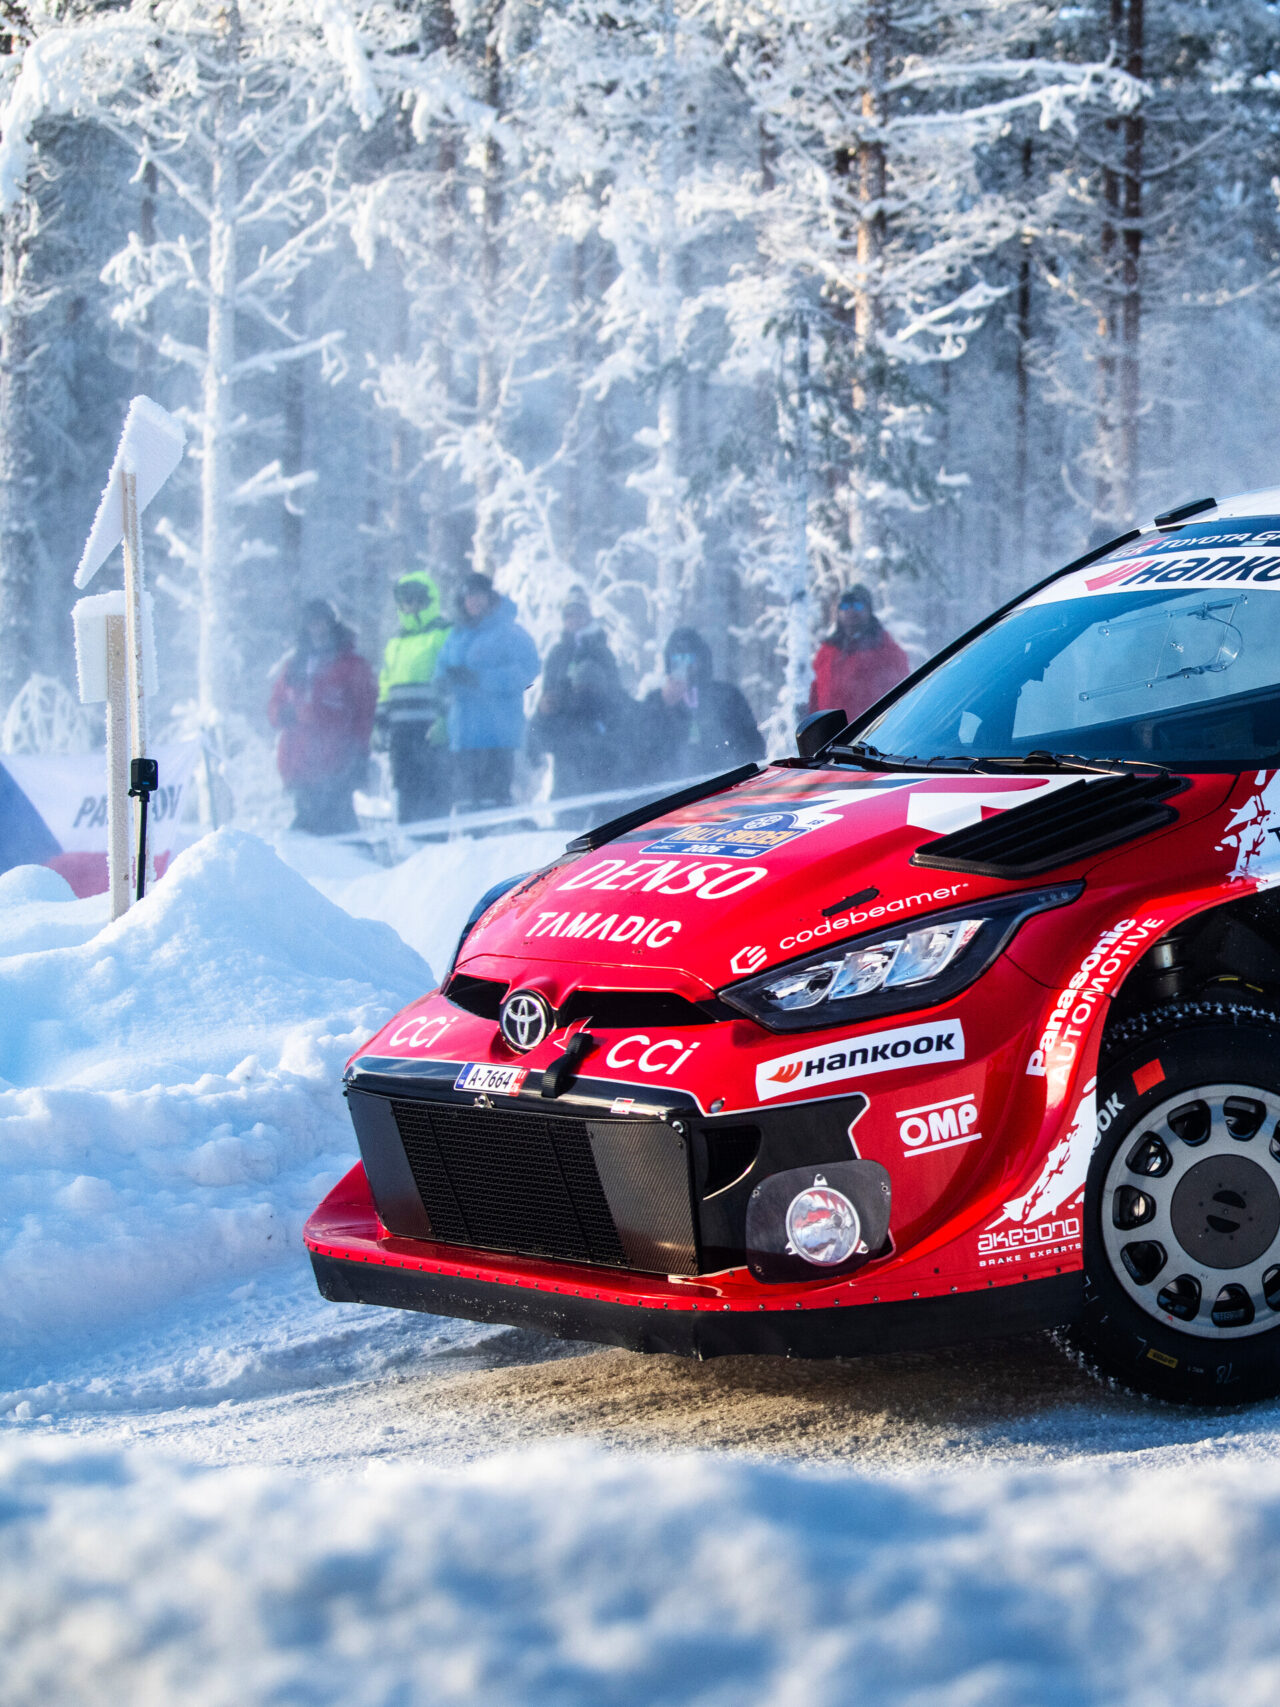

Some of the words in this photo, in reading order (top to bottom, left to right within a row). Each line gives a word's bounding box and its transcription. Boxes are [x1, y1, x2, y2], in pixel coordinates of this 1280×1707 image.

[1156, 532, 1252, 551] TOYOTA
[556, 859, 768, 900] DENSO
[525, 911, 682, 948] TAMADIC
[779, 884, 965, 950] codebeamer
[1026, 918, 1136, 1077] Panasonic
[1051, 916, 1165, 1086] AUTOMOTIVE
[468, 1068, 514, 1089] A-7664
[899, 1103, 978, 1147] OMP
[979, 1254, 1022, 1267] BRAKE
[1029, 1242, 1082, 1260] EXPERTS
